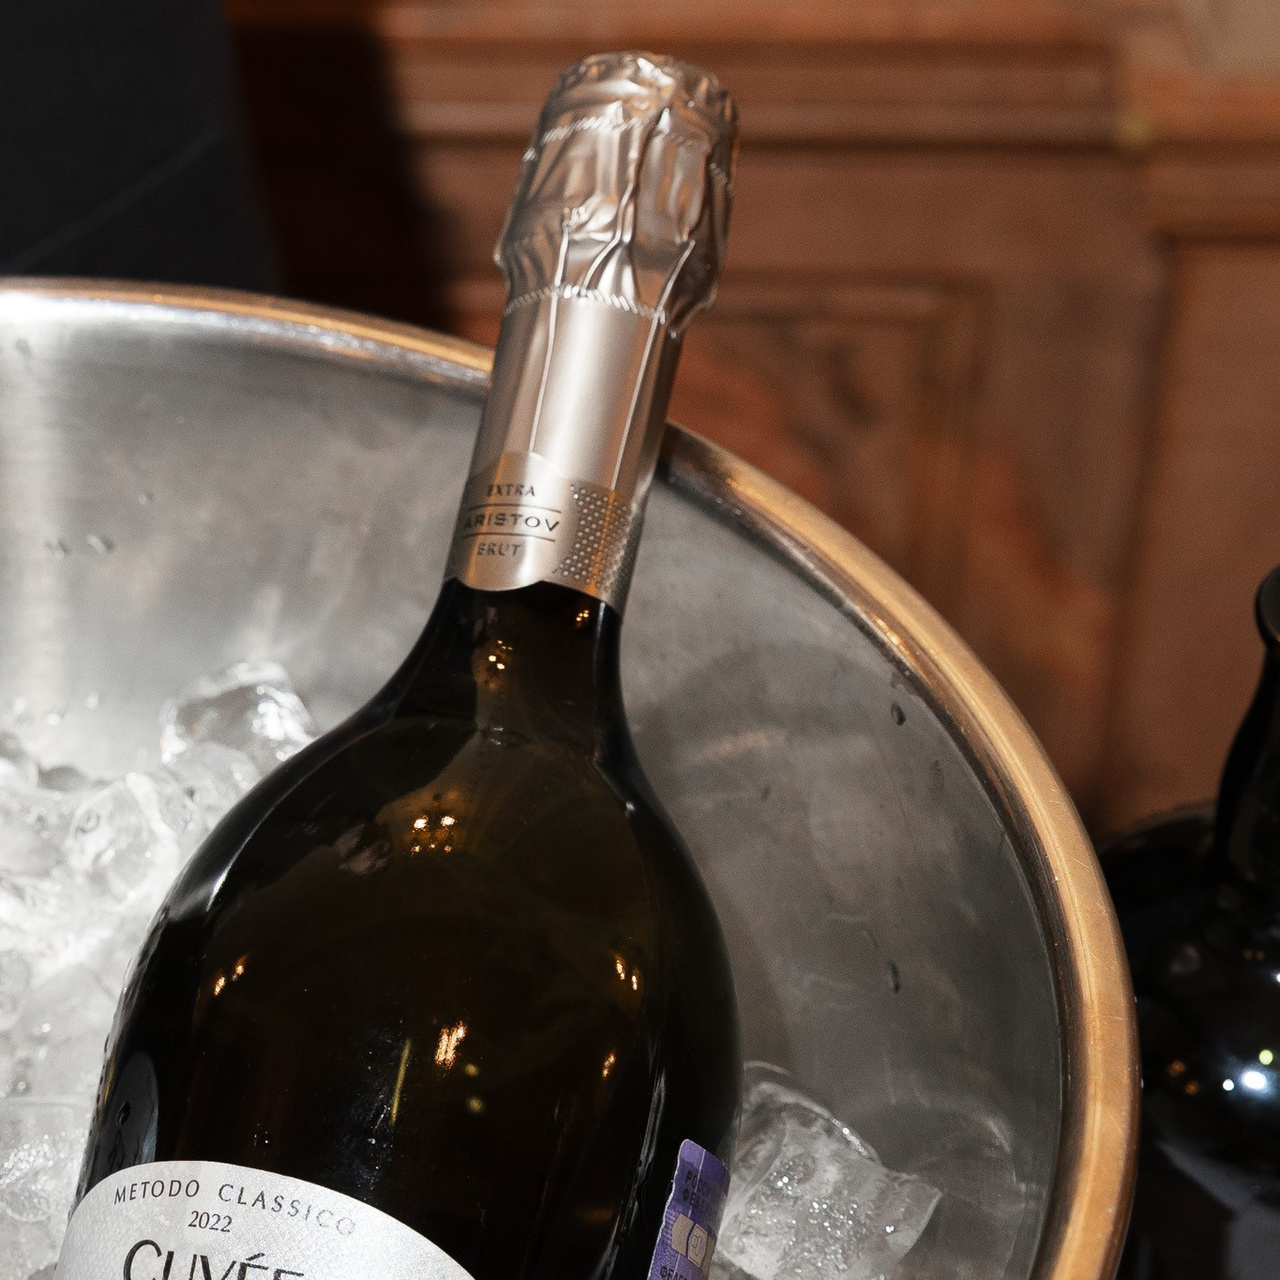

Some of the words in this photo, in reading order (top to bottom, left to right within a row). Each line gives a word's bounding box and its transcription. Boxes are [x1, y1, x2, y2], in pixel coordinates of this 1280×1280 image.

[477, 542, 522, 557] BRUT
[113, 1178, 201, 1206] METODO
[218, 1182, 357, 1237] CLASSICO
[187, 1209, 234, 1234] 2022
